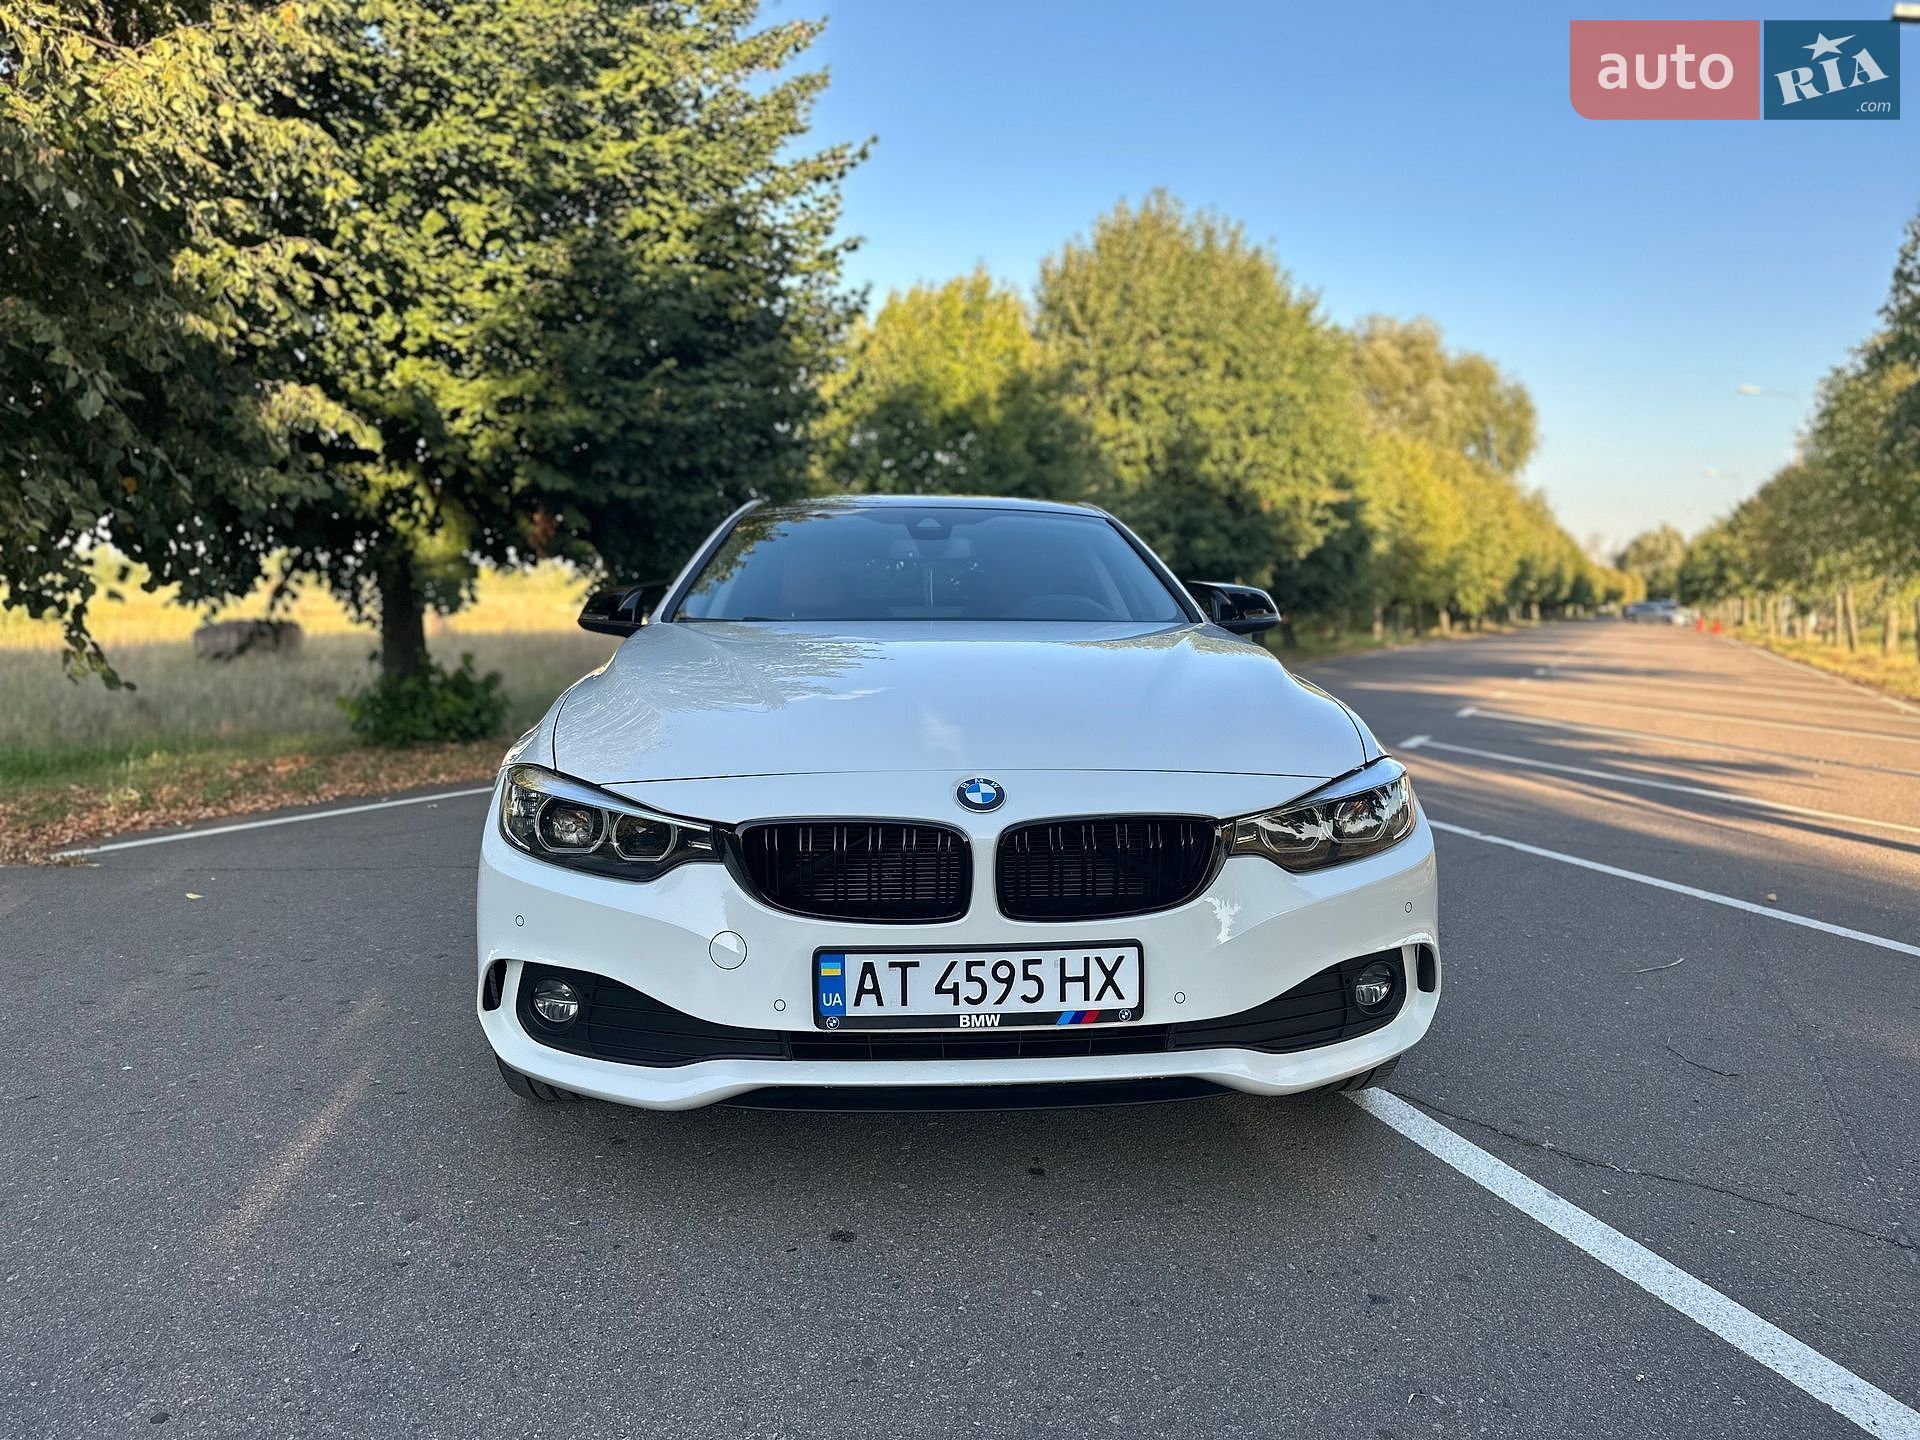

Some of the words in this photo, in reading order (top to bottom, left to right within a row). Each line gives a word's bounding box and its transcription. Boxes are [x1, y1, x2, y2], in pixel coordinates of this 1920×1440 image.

[960, 778, 1000, 789] BMW
[854, 961, 919, 1006] AT
[934, 959, 1044, 1006] 4595
[1059, 955, 1126, 1003] HX
[823, 993, 842, 1007] UA
[959, 1015, 1000, 1027] BMW
